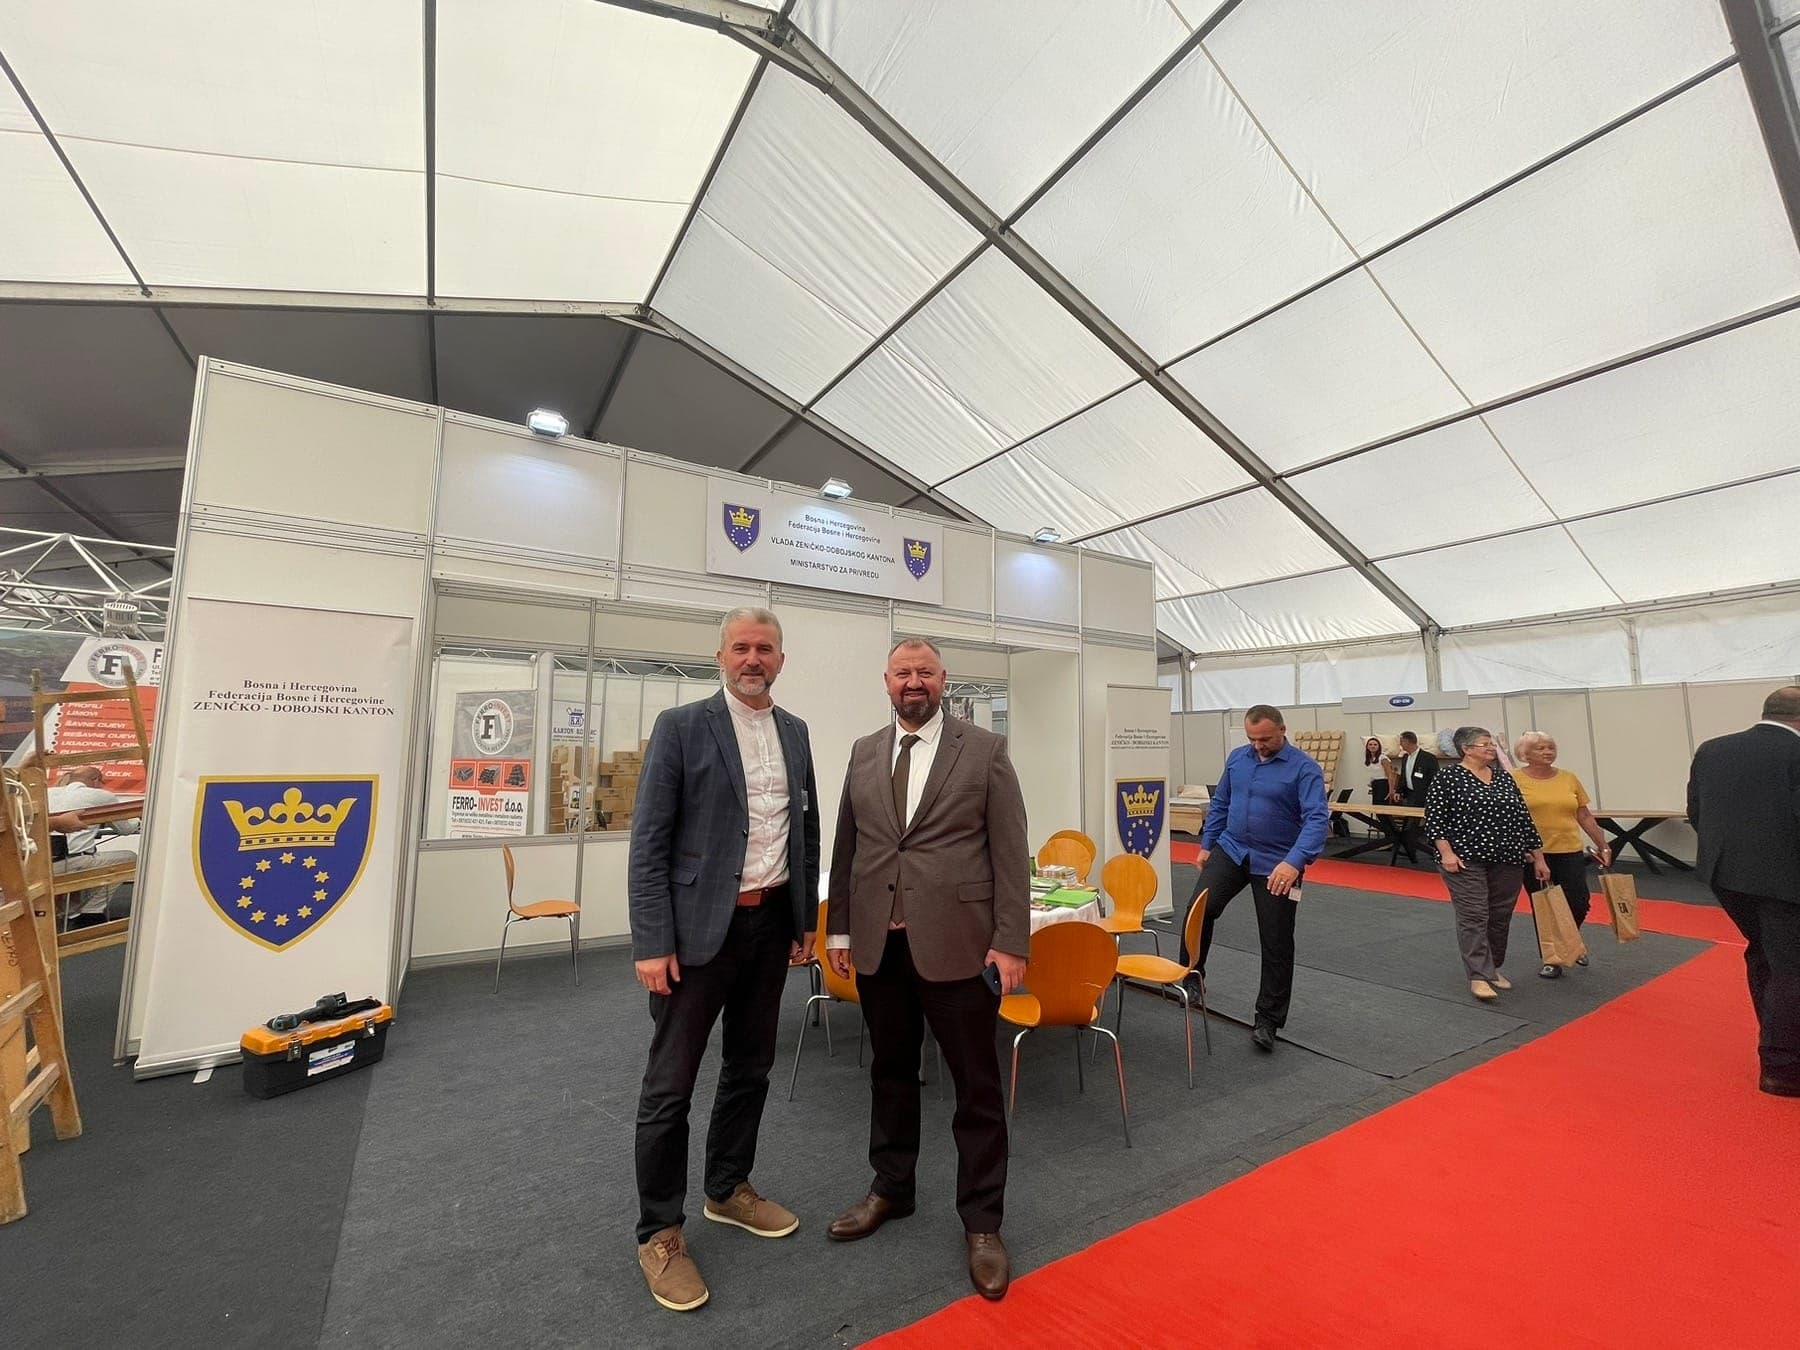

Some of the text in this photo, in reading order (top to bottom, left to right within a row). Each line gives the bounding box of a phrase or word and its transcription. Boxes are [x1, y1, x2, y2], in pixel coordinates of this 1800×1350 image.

[805, 514, 825, 524] Bosna
[830, 520, 866, 532] Hercegovina
[788, 520, 820, 534] Federacija
[822, 526, 840, 536] Bosne
[846, 532, 880, 544] Hercegovine
[771, 536, 794, 547] VLADA
[866, 554, 896, 564] KANTONA
[790, 558, 838, 573] MINISTARSTVO
[848, 568, 880, 579] PRIVREDU
[244, 680, 358, 694] Bosna i Hercegovina
[208, 690, 385, 706] Federacija Bosne i Hercegovine
[192, 700, 261, 712] ZENIČKO
[272, 704, 339, 714] DOBOJSKI
[342, 706, 395, 716] KANTON
[452, 796, 478, 810] FERRO-
[478, 797, 504, 812] INVEST
